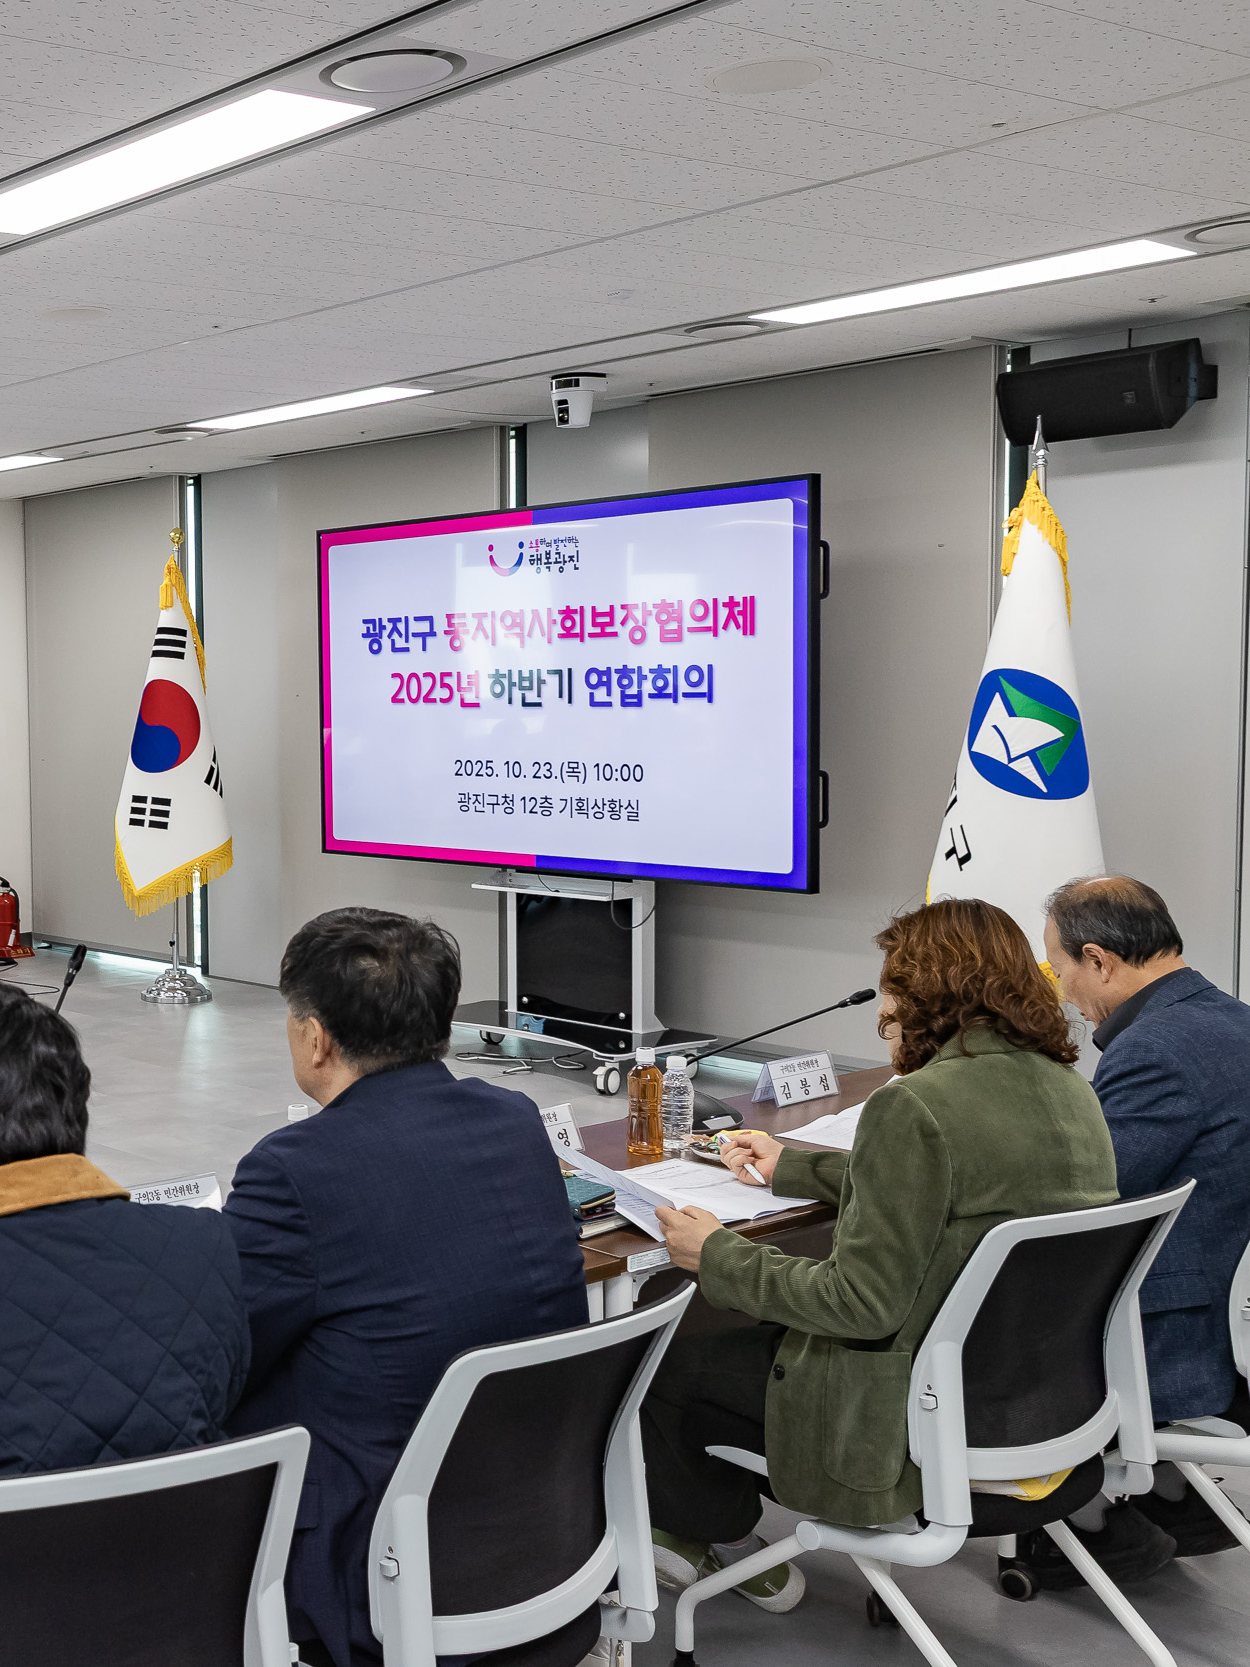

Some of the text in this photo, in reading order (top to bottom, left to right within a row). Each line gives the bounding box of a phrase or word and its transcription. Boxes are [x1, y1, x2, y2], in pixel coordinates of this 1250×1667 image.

[528, 535, 580, 552] 소통하며 발전하는
[528, 550, 580, 574] 행복광진
[361, 595, 756, 655] 광진구 동지역사회보장협의체
[389, 663, 715, 708] 2025년 하반기 연합회의
[454, 759, 499, 778] 2025.
[504, 760, 527, 779] 10.
[593, 762, 644, 783] 10:00
[457, 791, 641, 822] 광진구청 12층 기획상황실
[134, 1182, 200, 1204] 구의3동 민간위원장
